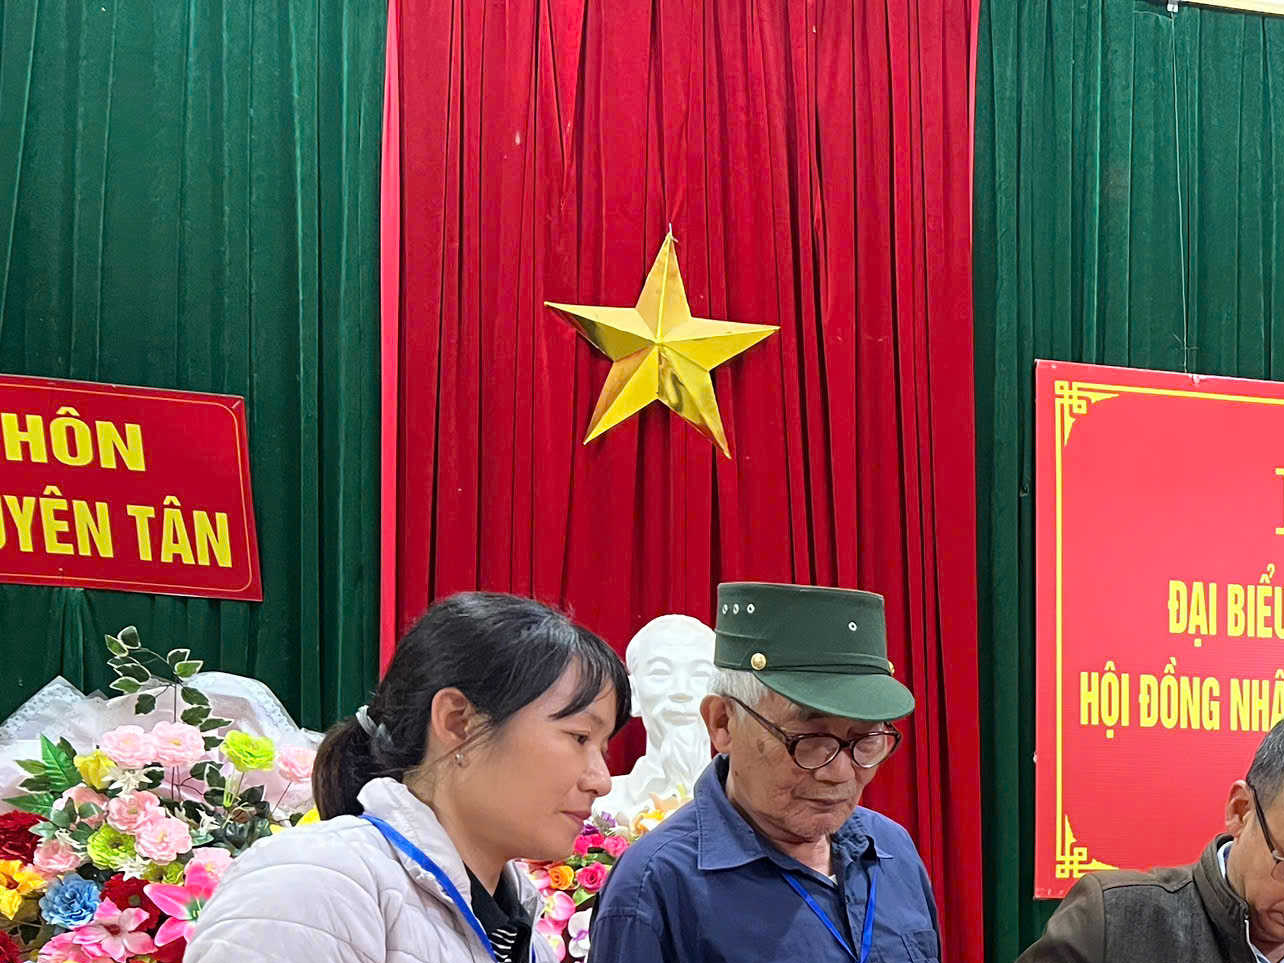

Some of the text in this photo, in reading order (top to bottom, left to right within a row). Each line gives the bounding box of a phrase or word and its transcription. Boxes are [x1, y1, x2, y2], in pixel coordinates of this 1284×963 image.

[0, 485, 233, 568] YÊN TÂN
[1167, 579, 1218, 648] ĐẠI
[1080, 660, 1130, 739] HỘI
[1138, 657, 1221, 731] ĐỒNG
